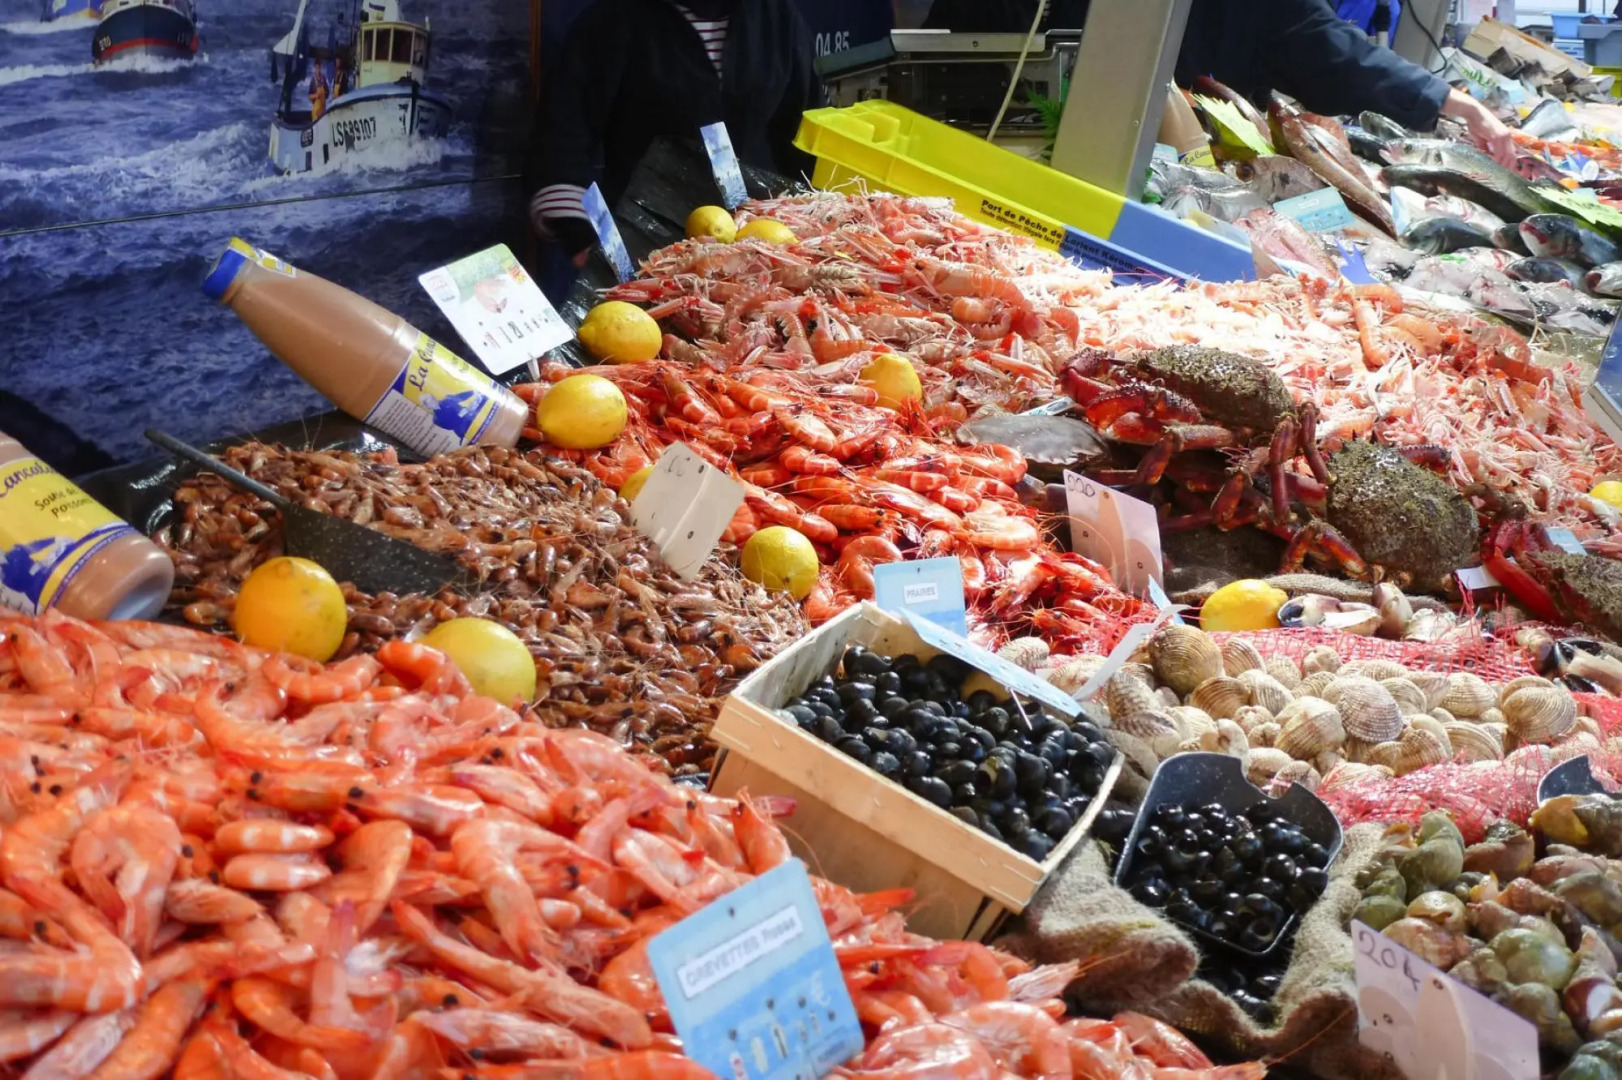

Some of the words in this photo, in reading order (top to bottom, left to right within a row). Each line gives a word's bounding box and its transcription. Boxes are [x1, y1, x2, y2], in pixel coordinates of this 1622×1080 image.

[981, 199, 1002, 214] Port
[1004, 210, 1017, 219] de
[1018, 215, 1049, 233] Pêche
[1050, 229, 1063, 239] de
[1064, 234, 1100, 256] Lorient
[408, 366, 428, 391] La
[685, 935, 760, 988] CREVETTES
